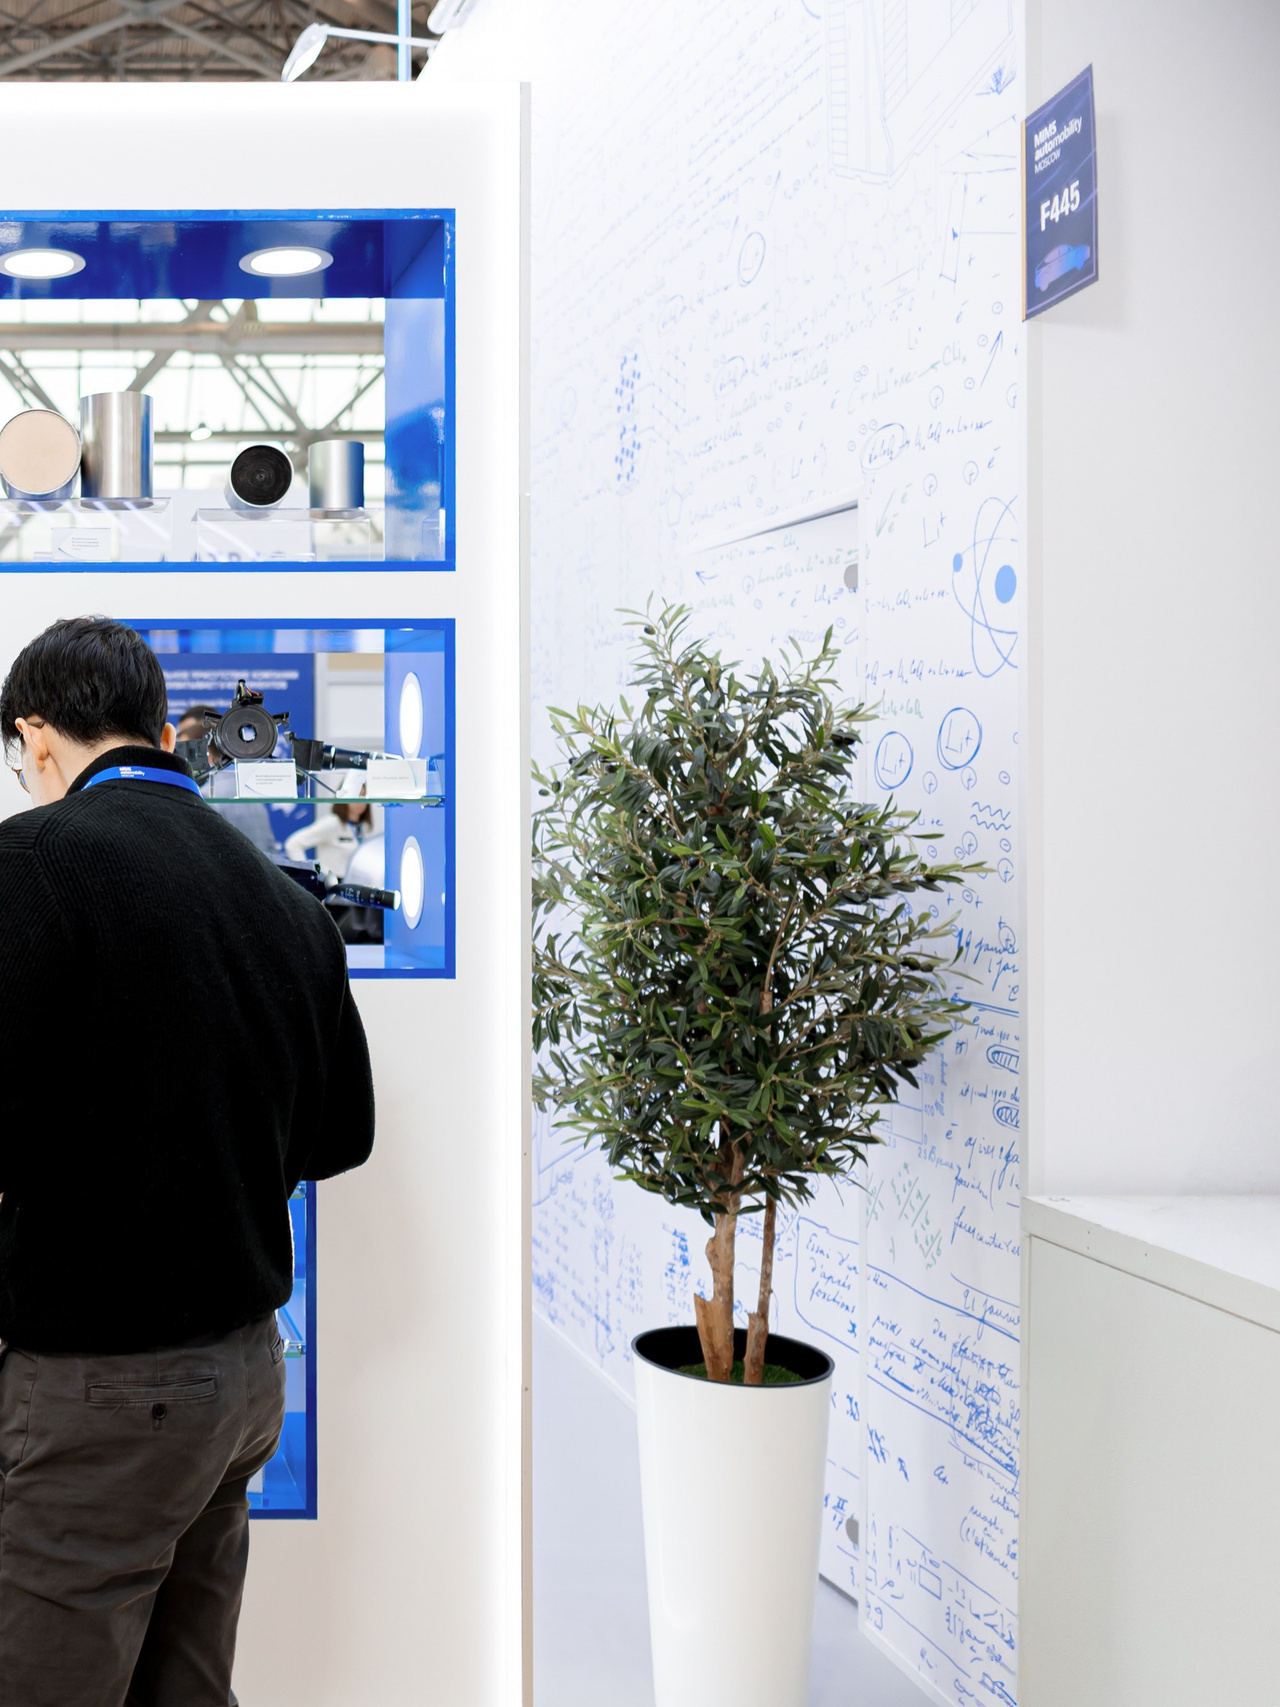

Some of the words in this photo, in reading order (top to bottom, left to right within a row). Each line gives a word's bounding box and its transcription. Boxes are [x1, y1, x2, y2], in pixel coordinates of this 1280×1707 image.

[1034, 120, 1057, 148] MIMS
[1034, 116, 1083, 162] automobility
[1034, 150, 1061, 174] MOSCOW
[1040, 180, 1081, 232] F445
